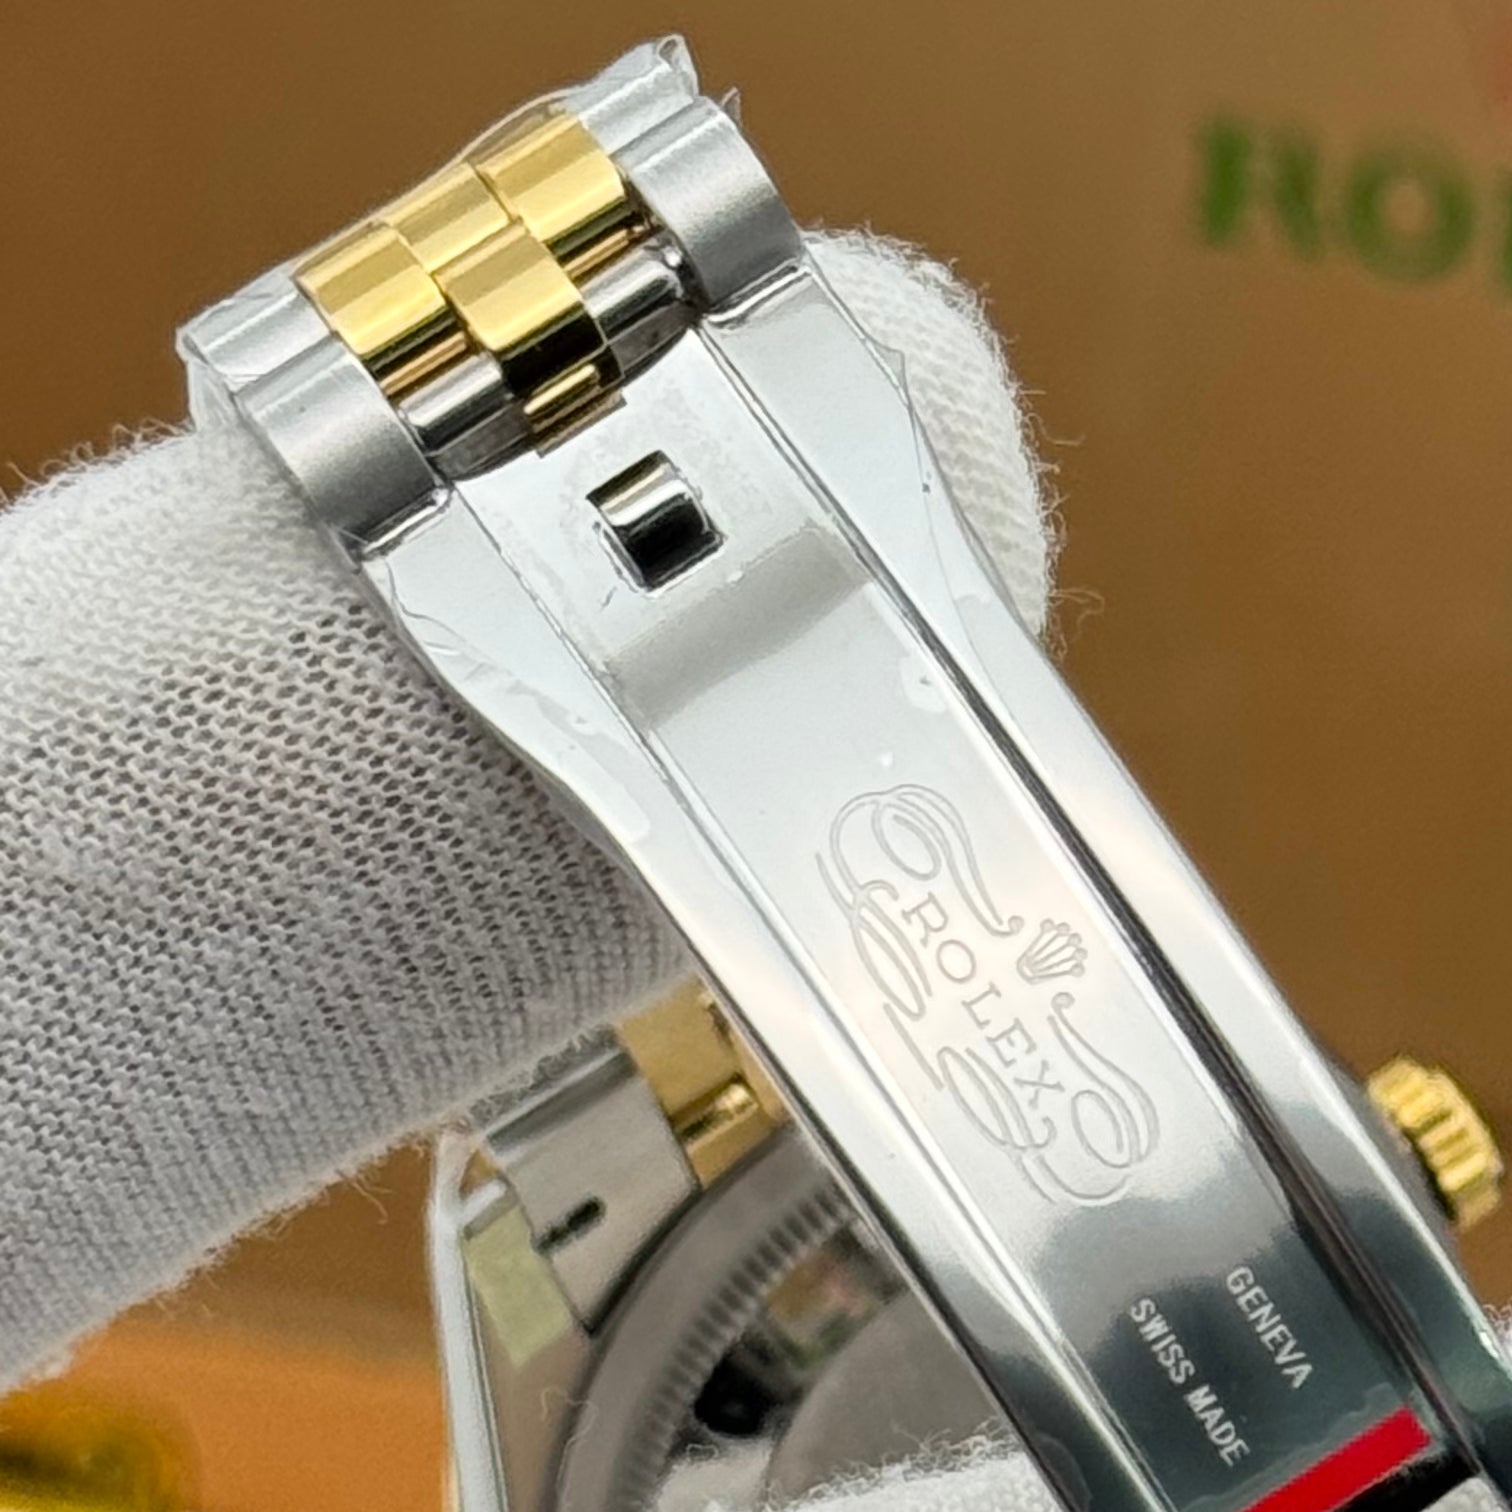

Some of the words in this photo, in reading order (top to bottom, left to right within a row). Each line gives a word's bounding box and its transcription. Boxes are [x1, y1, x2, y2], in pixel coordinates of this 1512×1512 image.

[901, 892, 1065, 1110] ROLEX
[1130, 1298, 1195, 1384] SWISS
[1184, 1385, 1250, 1467] MADE
[1226, 1266, 1313, 1389] GENEVA
